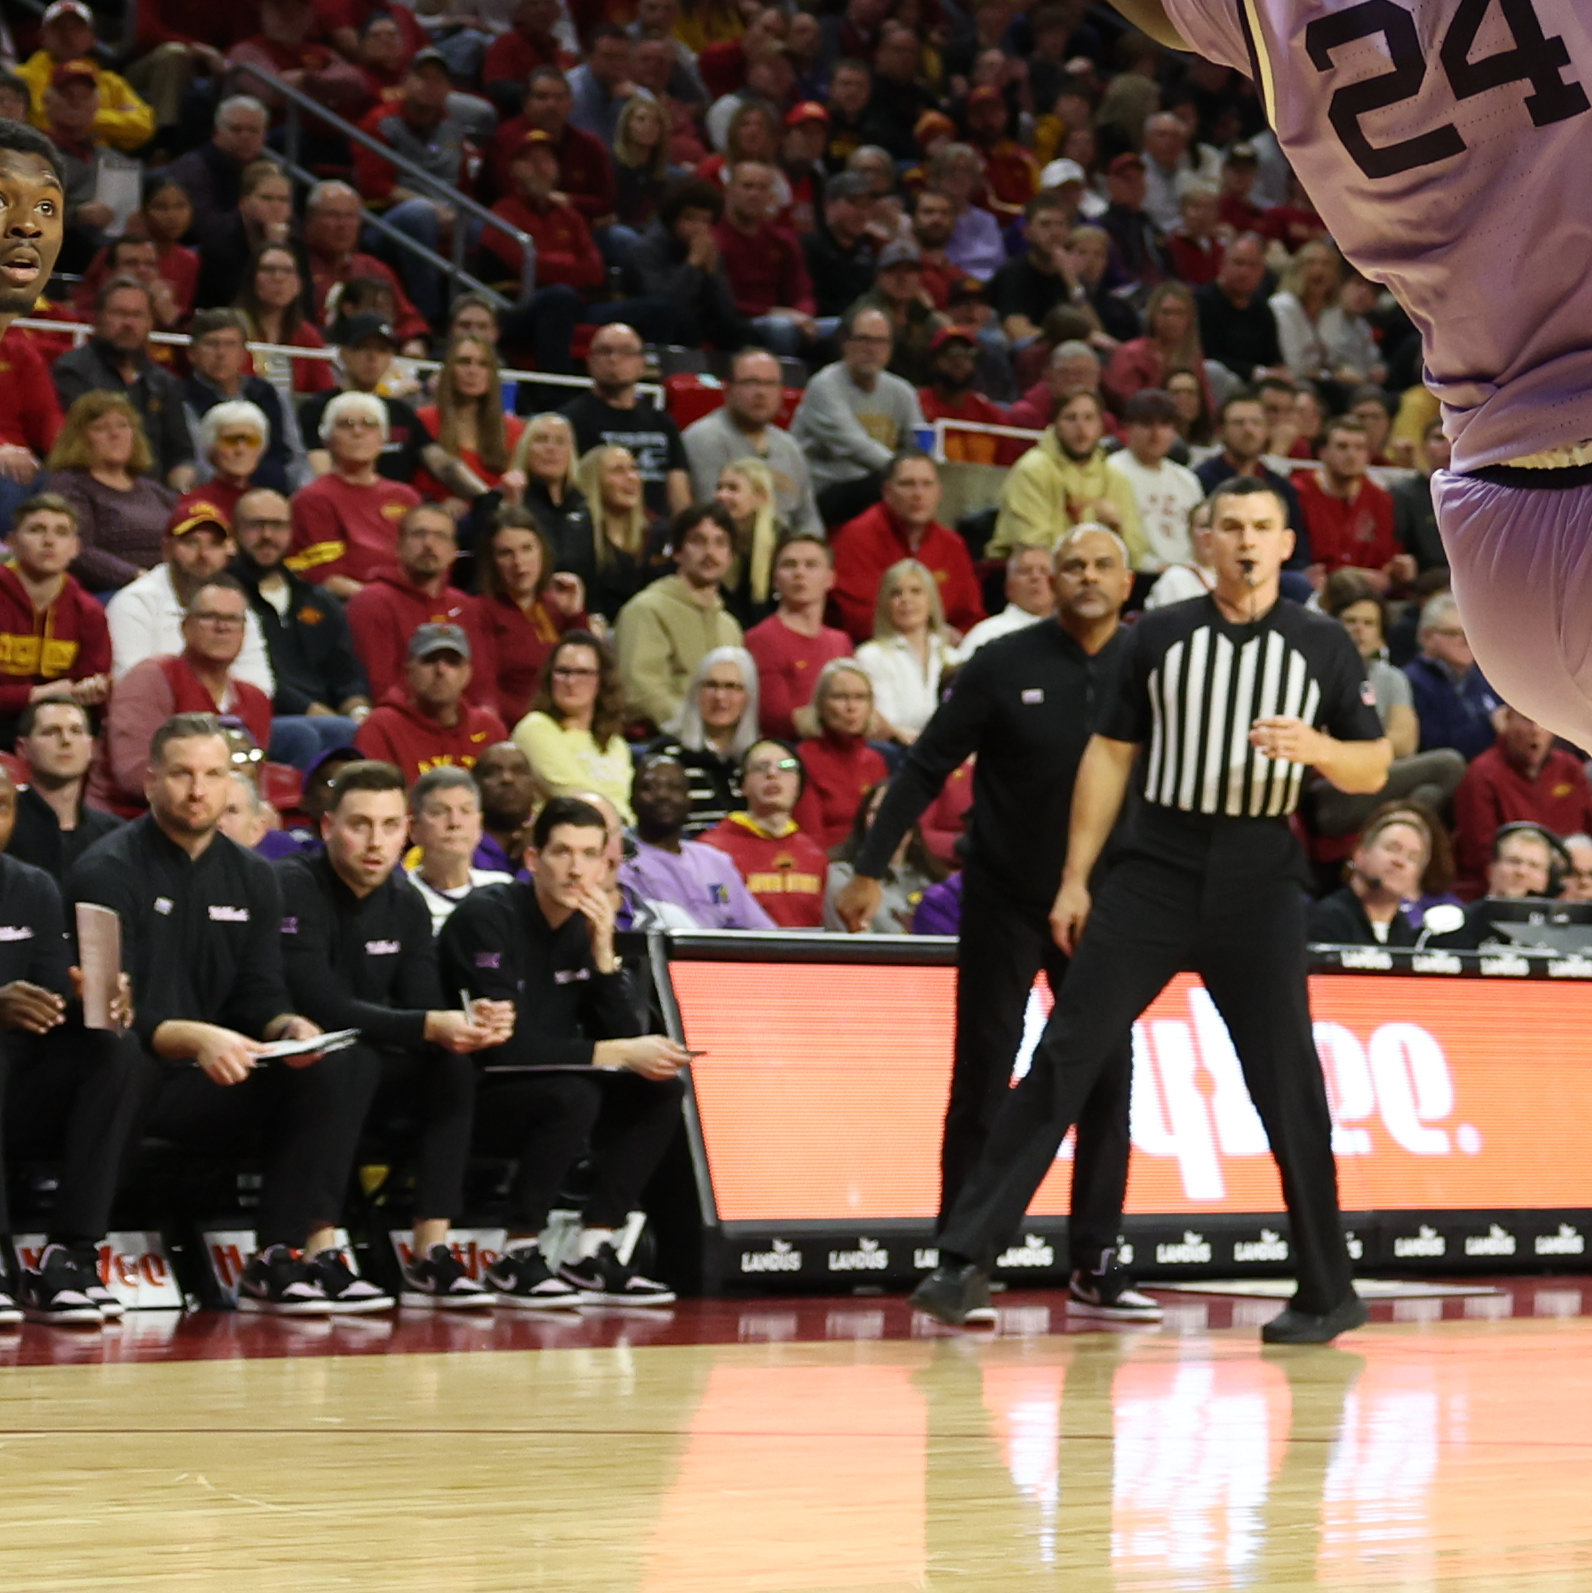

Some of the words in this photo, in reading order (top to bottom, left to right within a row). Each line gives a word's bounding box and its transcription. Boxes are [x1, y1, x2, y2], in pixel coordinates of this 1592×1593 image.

[741, 1250, 801, 1272] LANDUS
[828, 1249, 888, 1271] LANDUS
[1156, 1243, 1211, 1263] LANDUS
[1233, 1241, 1289, 1261] LANDUS
